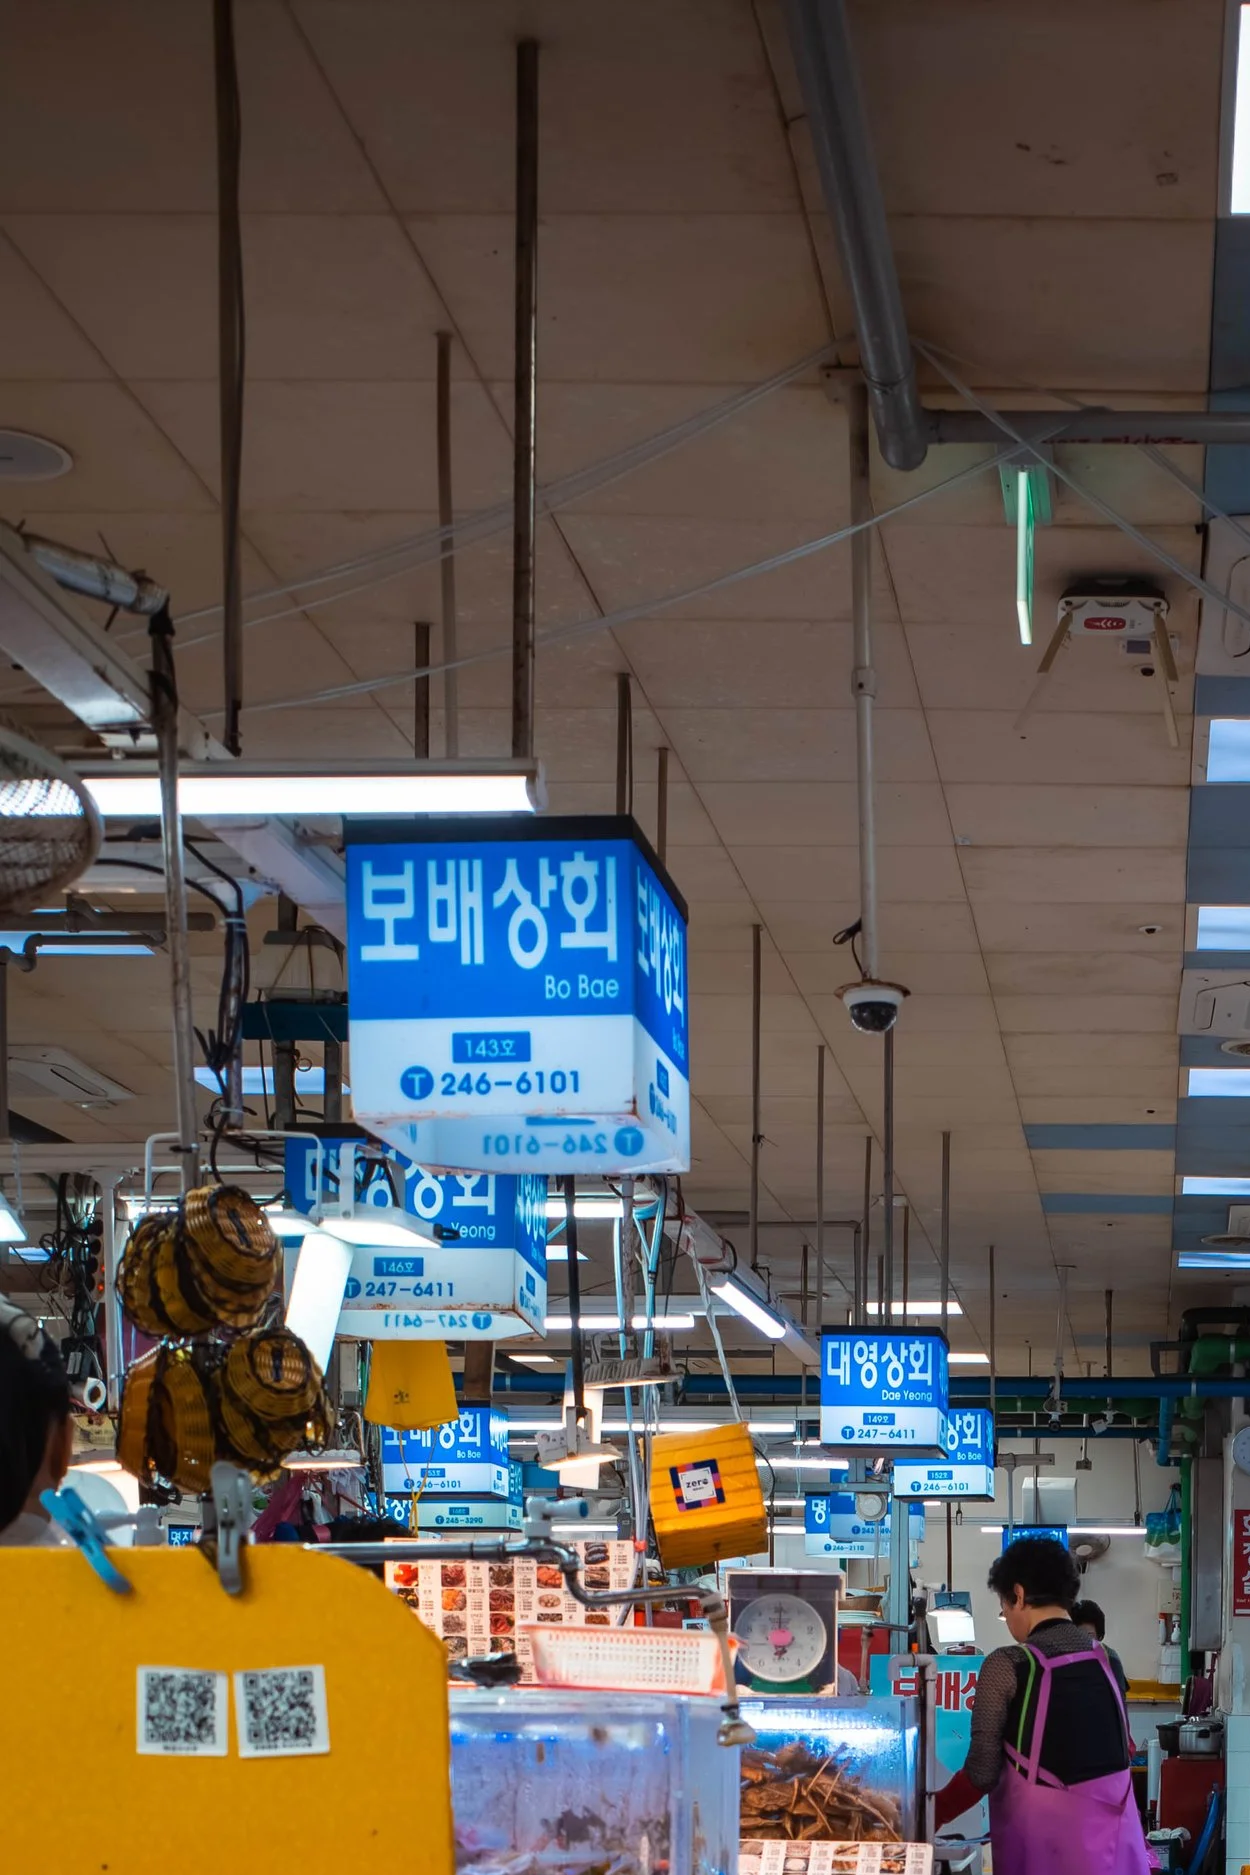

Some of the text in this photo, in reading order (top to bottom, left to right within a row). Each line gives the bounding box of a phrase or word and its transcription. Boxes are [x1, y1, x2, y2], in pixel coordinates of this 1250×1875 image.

[361, 852, 617, 969] 보배상회
[637, 865, 684, 1028] 보배상회
[545, 974, 619, 999] Bo Bae
[465, 1039, 515, 1058] 143호
[441, 1071, 580, 1096] 246-6101
[381, 1261, 415, 1274] 146호
[365, 1281, 455, 1298] 247-6411
[827, 1340, 933, 1389] 대영상회
[881, 1390, 933, 1403] Dae Yeong
[867, 1415, 890, 1424] 149호
[857, 1428, 916, 1440] 247-6411
[957, 1452, 982, 1461] Bo Bae
[923, 1482, 969, 1492] 246-6101
